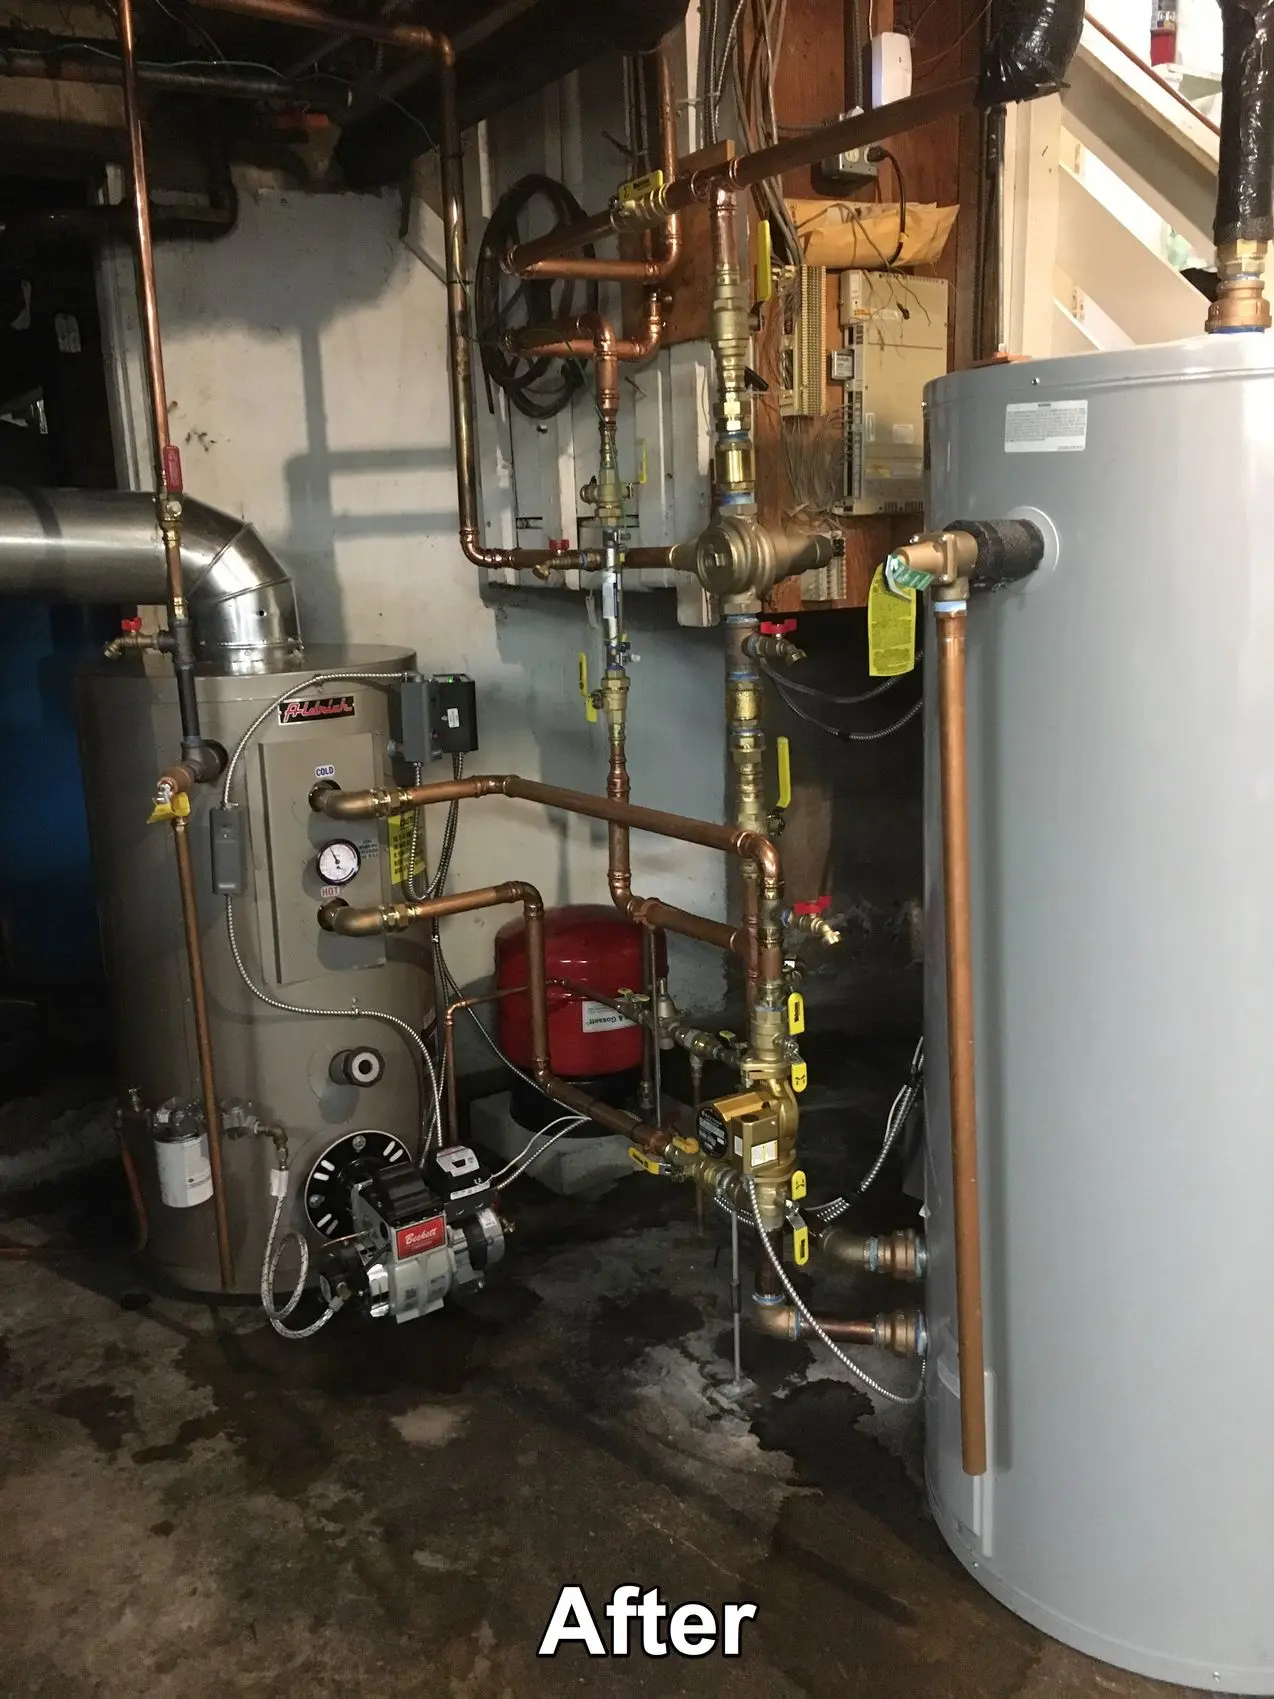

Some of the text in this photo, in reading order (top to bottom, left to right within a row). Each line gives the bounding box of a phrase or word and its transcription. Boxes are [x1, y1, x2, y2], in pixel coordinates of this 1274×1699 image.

[316, 766, 334, 776] COLD
[322, 887, 338, 897] HOT
[589, 1016, 617, 1024] Gossett
[404, 1227, 437, 1245] Beckett
